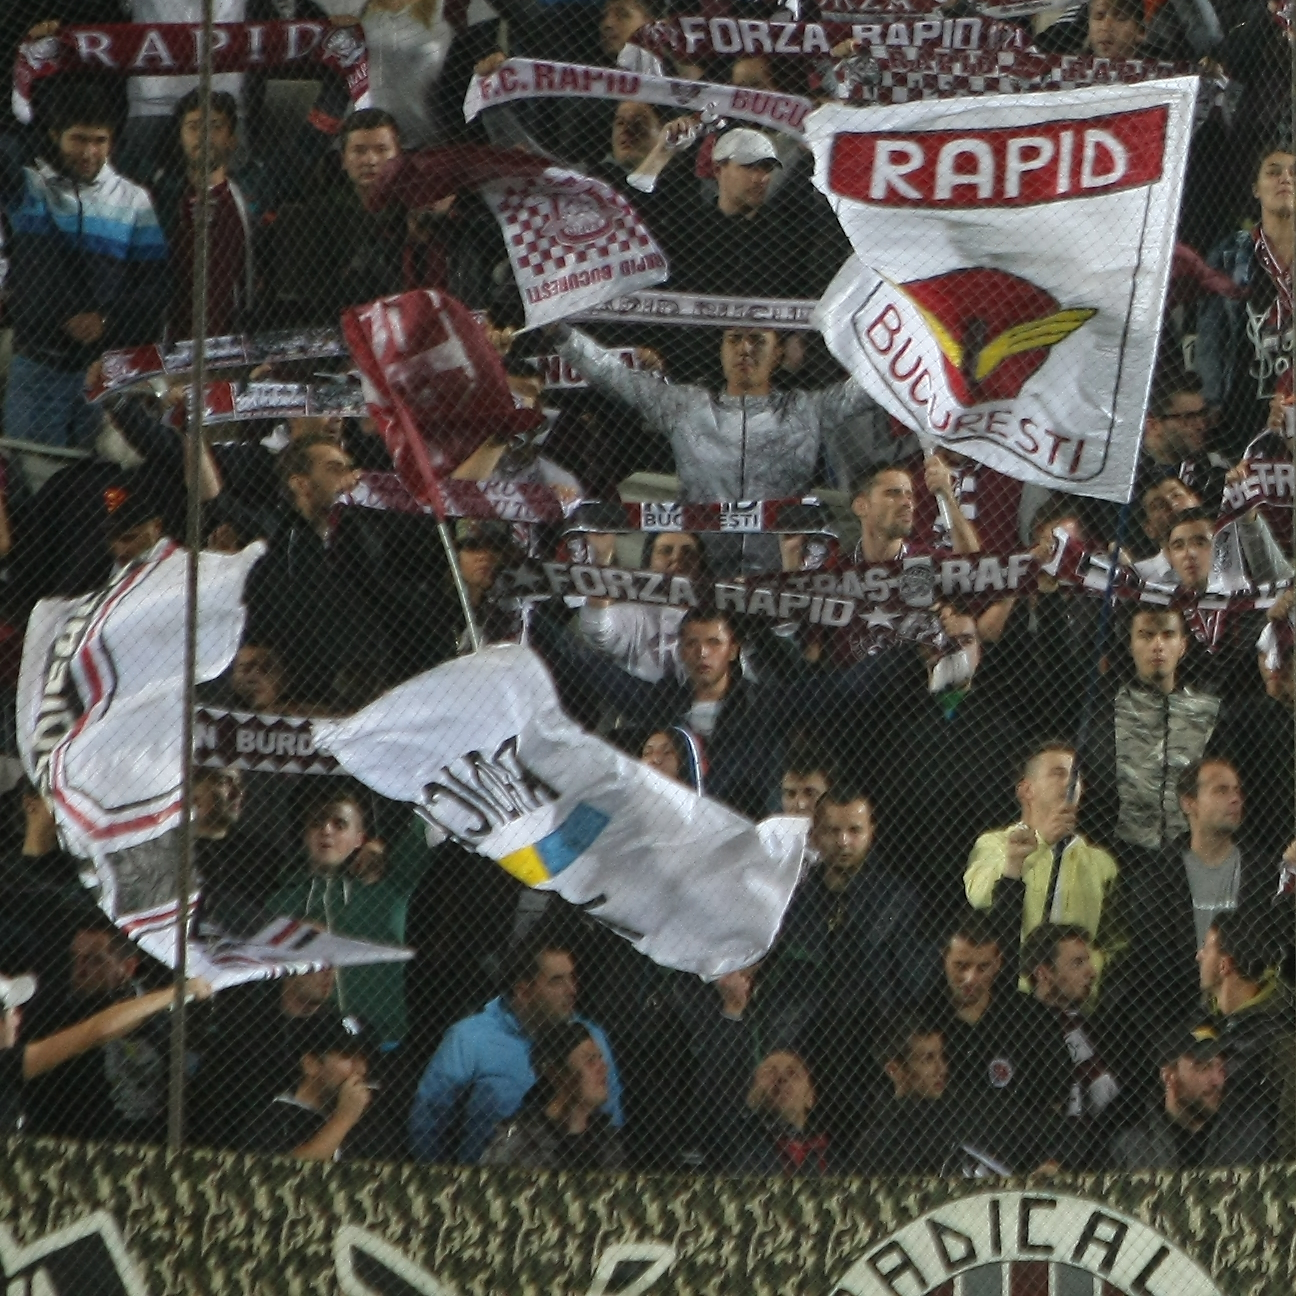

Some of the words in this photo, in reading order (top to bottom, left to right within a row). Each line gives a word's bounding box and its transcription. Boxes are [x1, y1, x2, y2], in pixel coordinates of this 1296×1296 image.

[76, 23, 328, 70] RAPID
[678, 17, 831, 54] FORZA
[851, 17, 982, 50] RAPID
[479, 65, 529, 101] F.C.
[533, 60, 641, 96] RAPID
[869, 128, 1130, 201] RAPID
[526, 265, 613, 304] BUCURESTI
[868, 303, 1088, 475] BUCURESTI
[547, 561, 695, 606] FORZA
[713, 581, 856, 627] RAPID
[866, 1197, 1173, 1296] ADICAL
